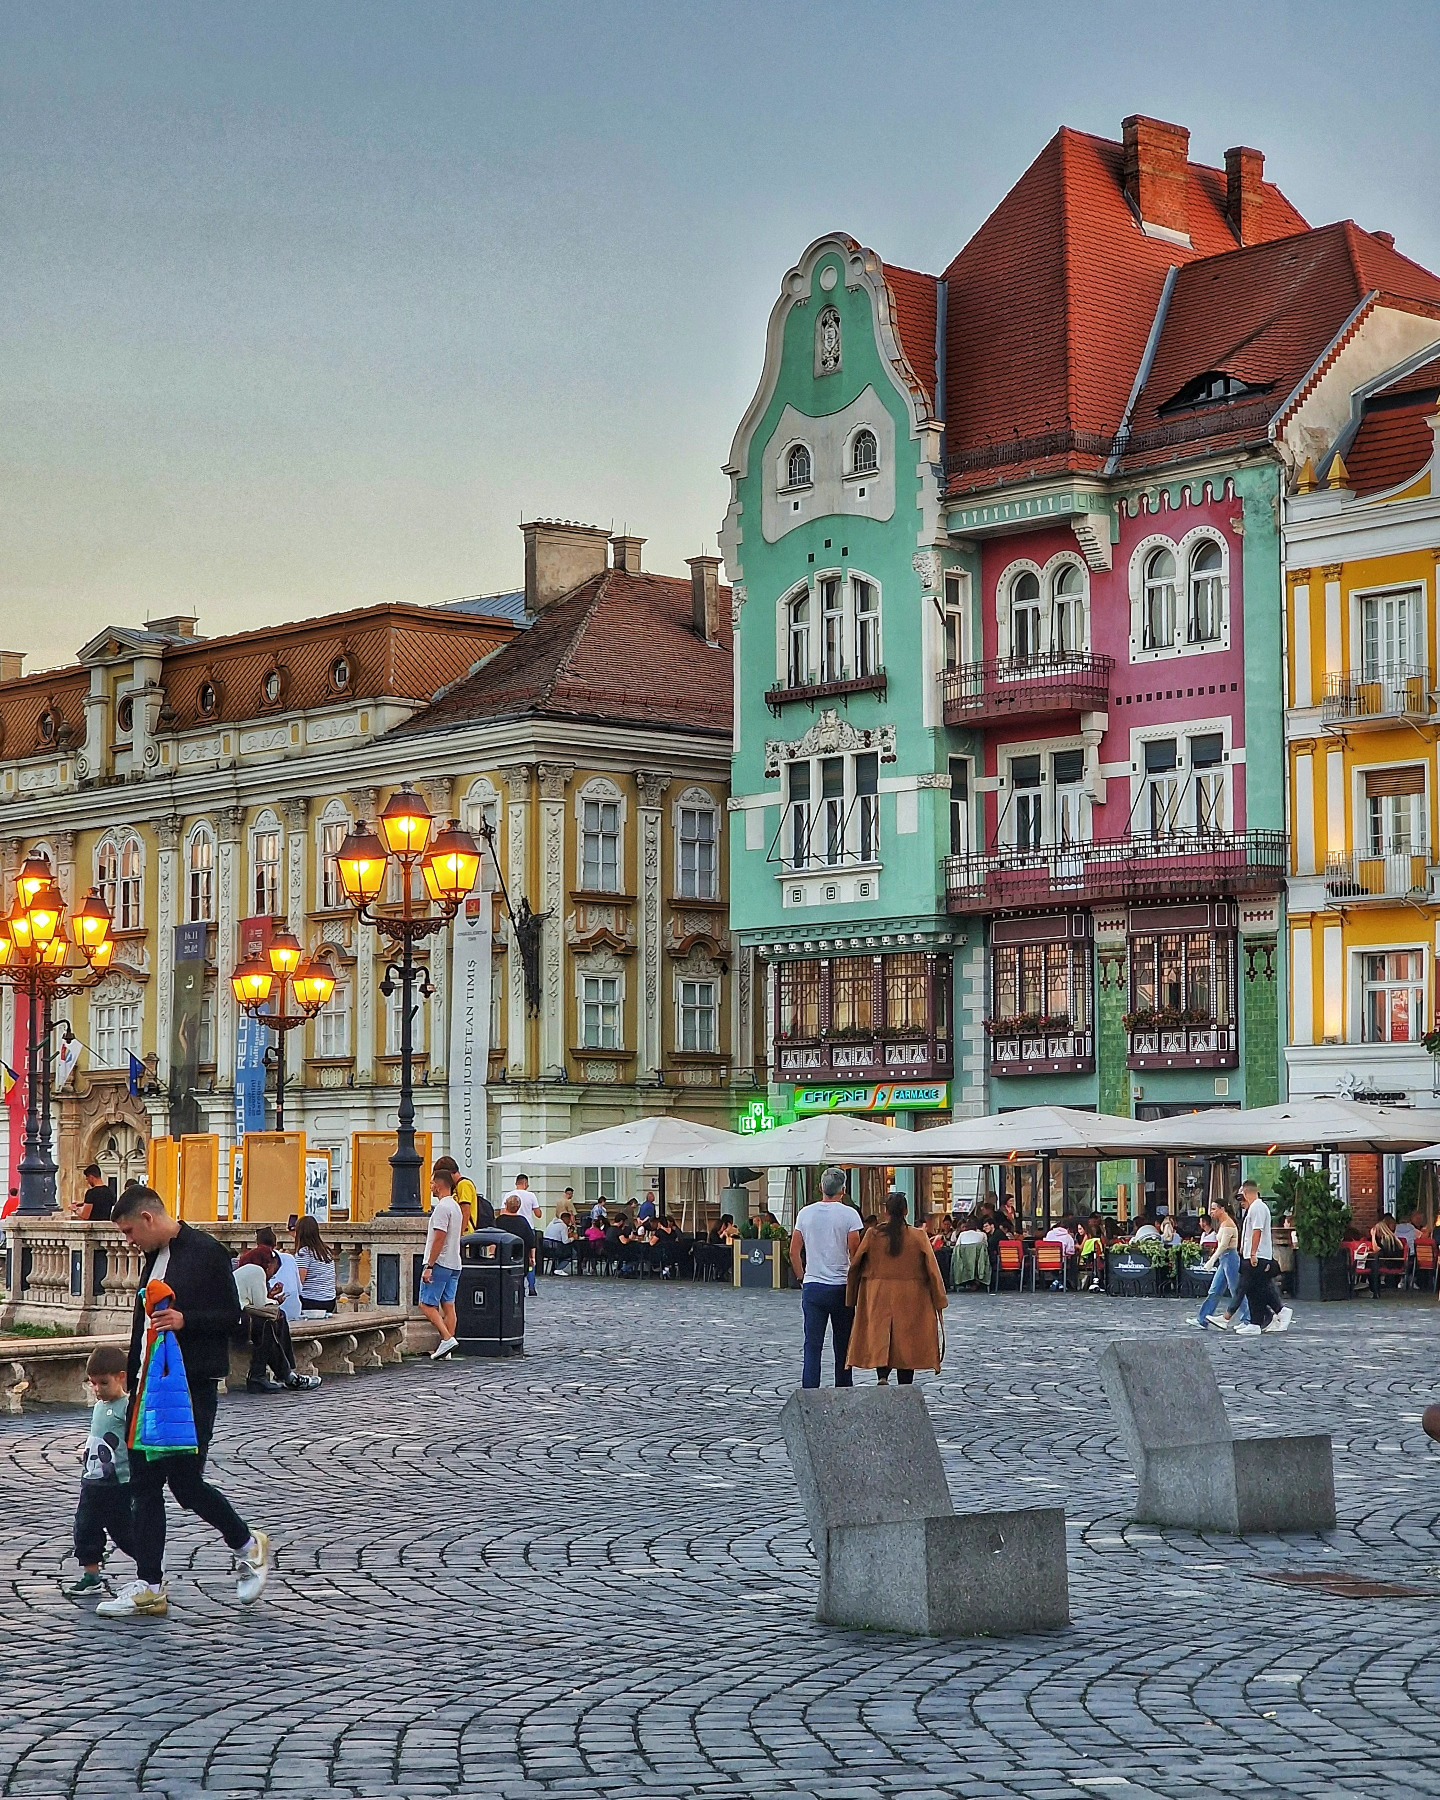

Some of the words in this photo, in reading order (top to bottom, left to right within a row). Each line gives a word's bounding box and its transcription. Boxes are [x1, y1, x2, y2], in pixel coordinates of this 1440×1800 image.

[236, 1082, 245, 1147] ROQUE
[464, 1087, 473, 1169] CONSILIUL
[803, 1089, 867, 1103] CATENA
[893, 1088, 940, 1100] FARMACIE
